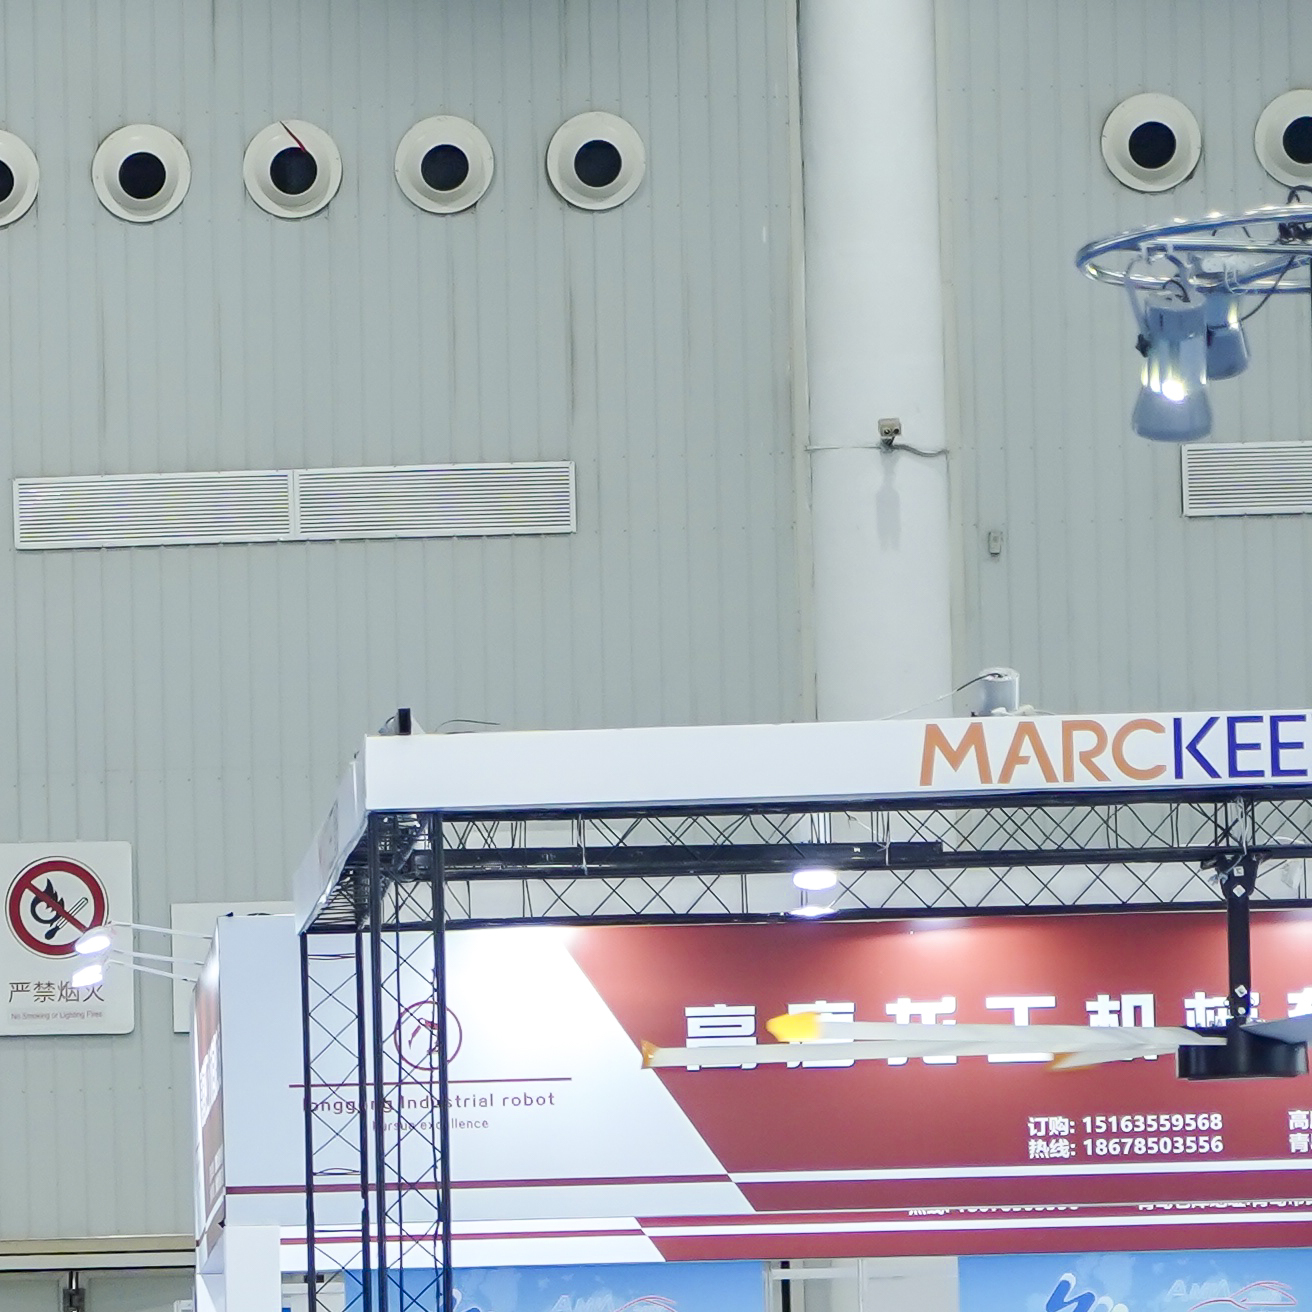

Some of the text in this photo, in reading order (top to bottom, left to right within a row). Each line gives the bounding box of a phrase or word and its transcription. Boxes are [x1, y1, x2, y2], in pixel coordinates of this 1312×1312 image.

[8, 981, 105, 1004] 严禁烟火
[502, 1092, 555, 1108] robot
[1082, 1112, 1223, 1134] 15163559568
[1028, 1135, 1224, 1159] 热线: 18678503556
